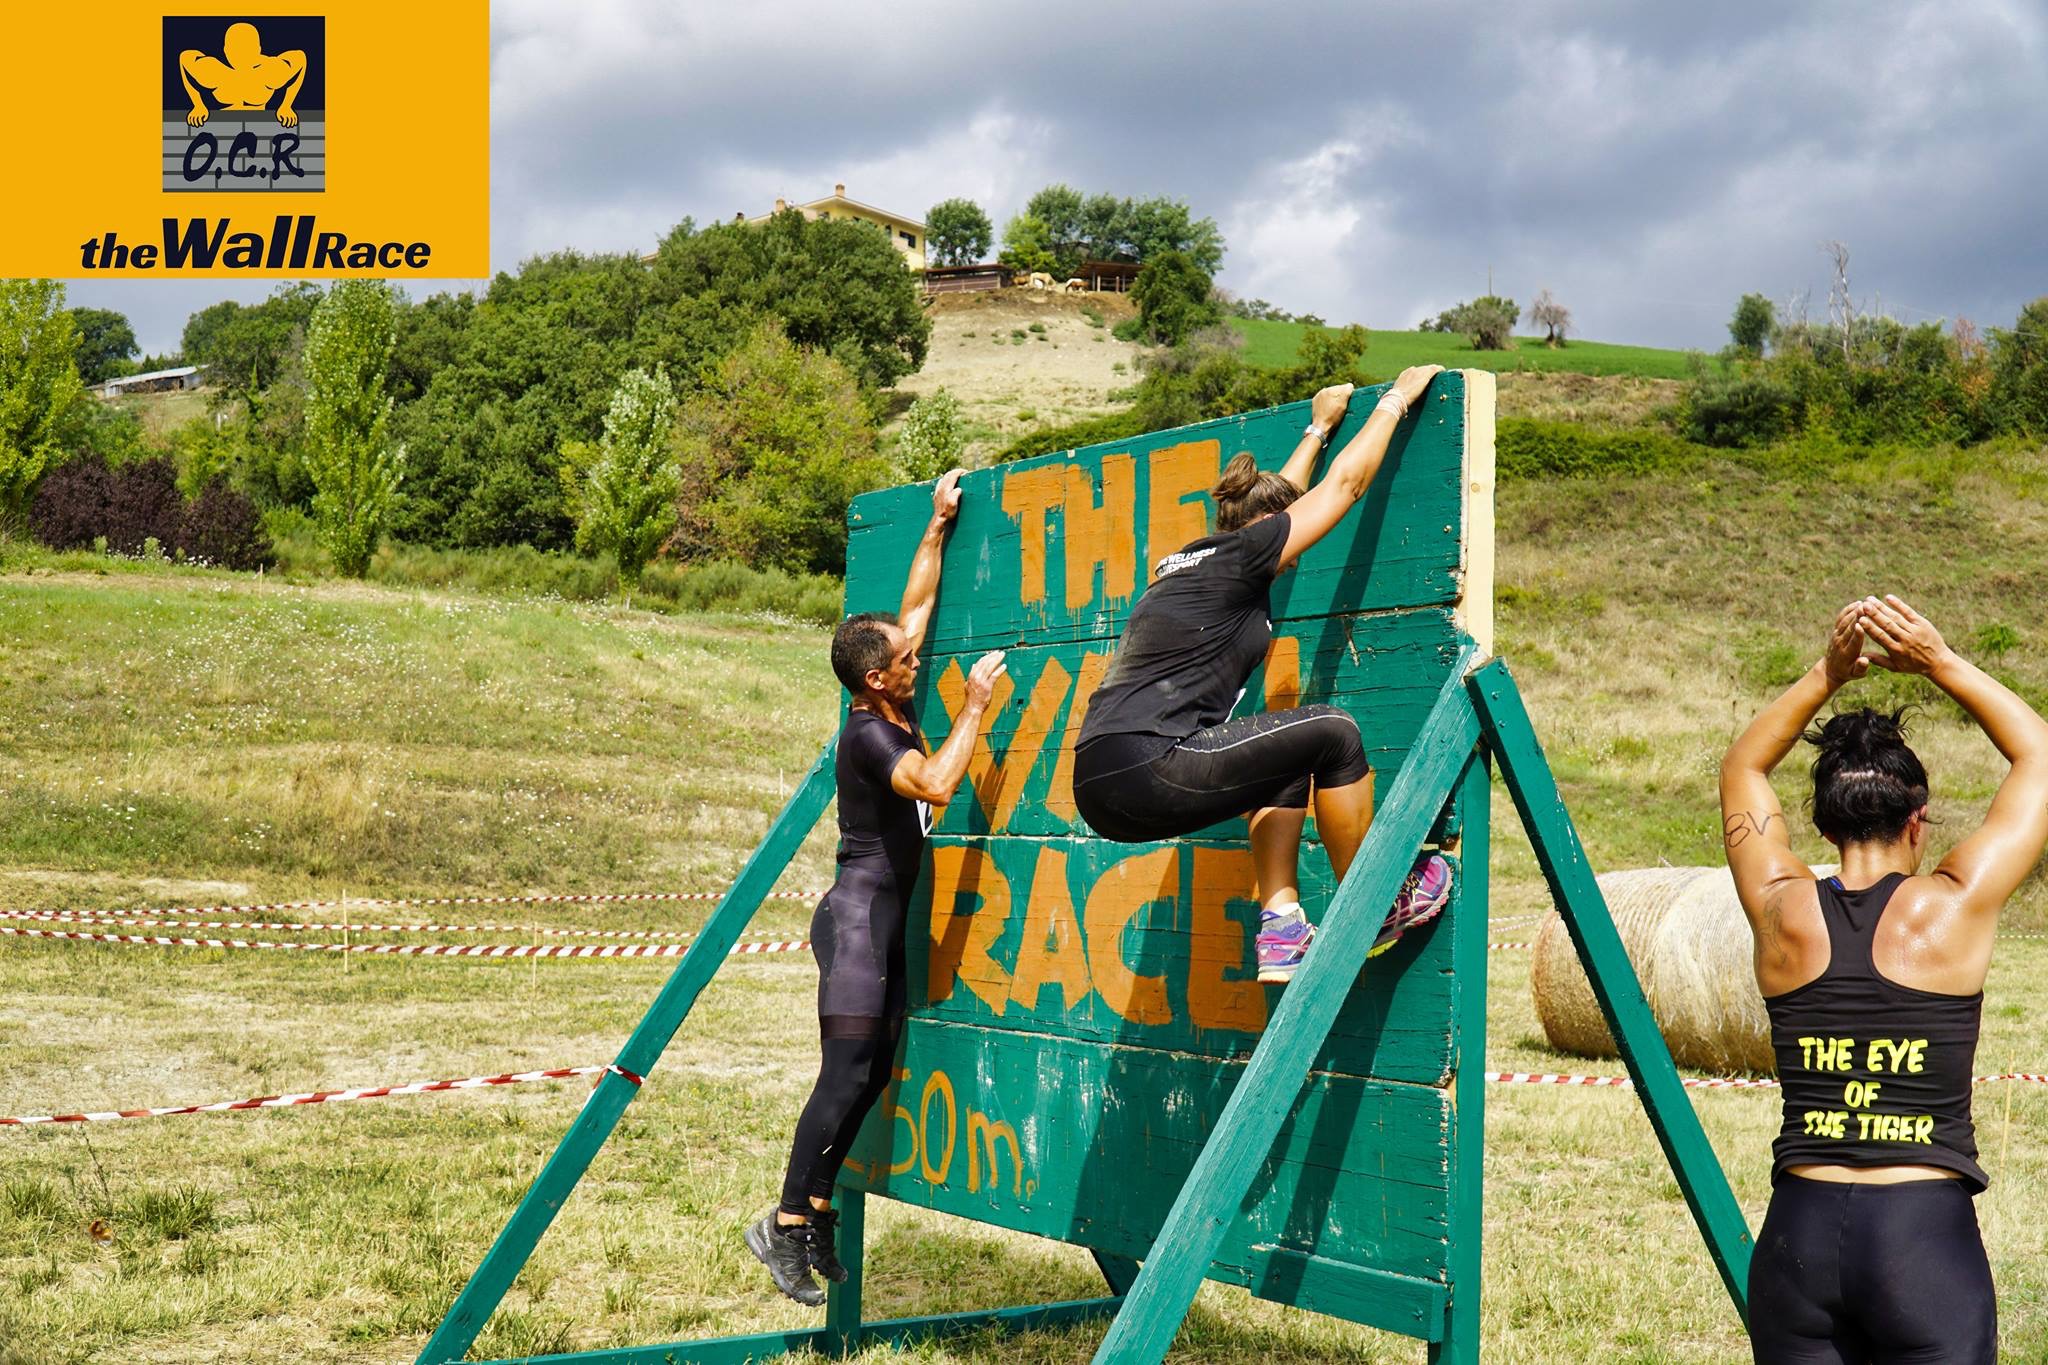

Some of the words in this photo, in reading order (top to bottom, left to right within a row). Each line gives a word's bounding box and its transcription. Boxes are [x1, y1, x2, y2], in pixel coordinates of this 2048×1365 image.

[1001, 438, 1221, 610] THE
[927, 844, 1269, 1031] RACE
[1798, 1036, 1855, 1071] THE
[1867, 1038, 1928, 1073] EYE
[1844, 1080, 1881, 1108] OF
[1804, 1110, 1849, 1139] THE
[1857, 1114, 1934, 1145] TIGER
